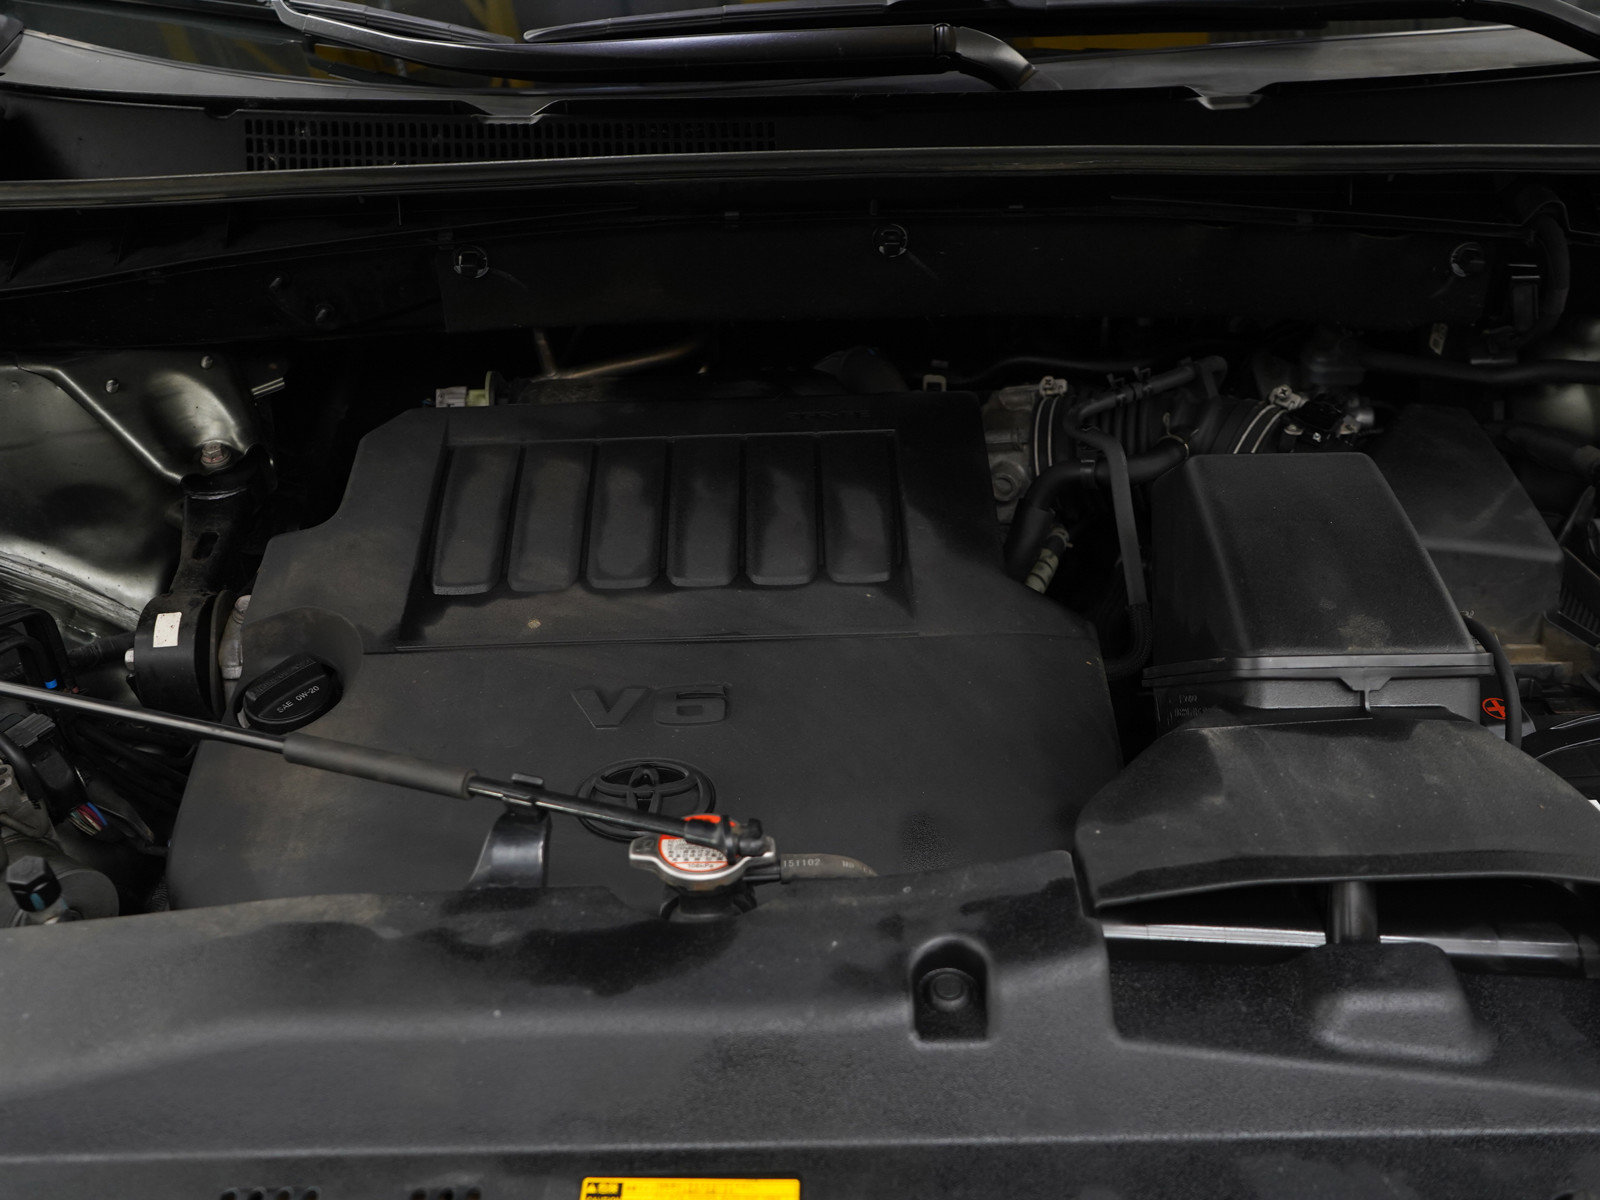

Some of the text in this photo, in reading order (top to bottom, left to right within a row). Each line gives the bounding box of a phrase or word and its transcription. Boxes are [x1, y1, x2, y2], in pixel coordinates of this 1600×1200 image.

[277, 686, 320, 713] SAE 0W-20
[570, 684, 728, 729] V6
[783, 857, 821, 868] 151102
